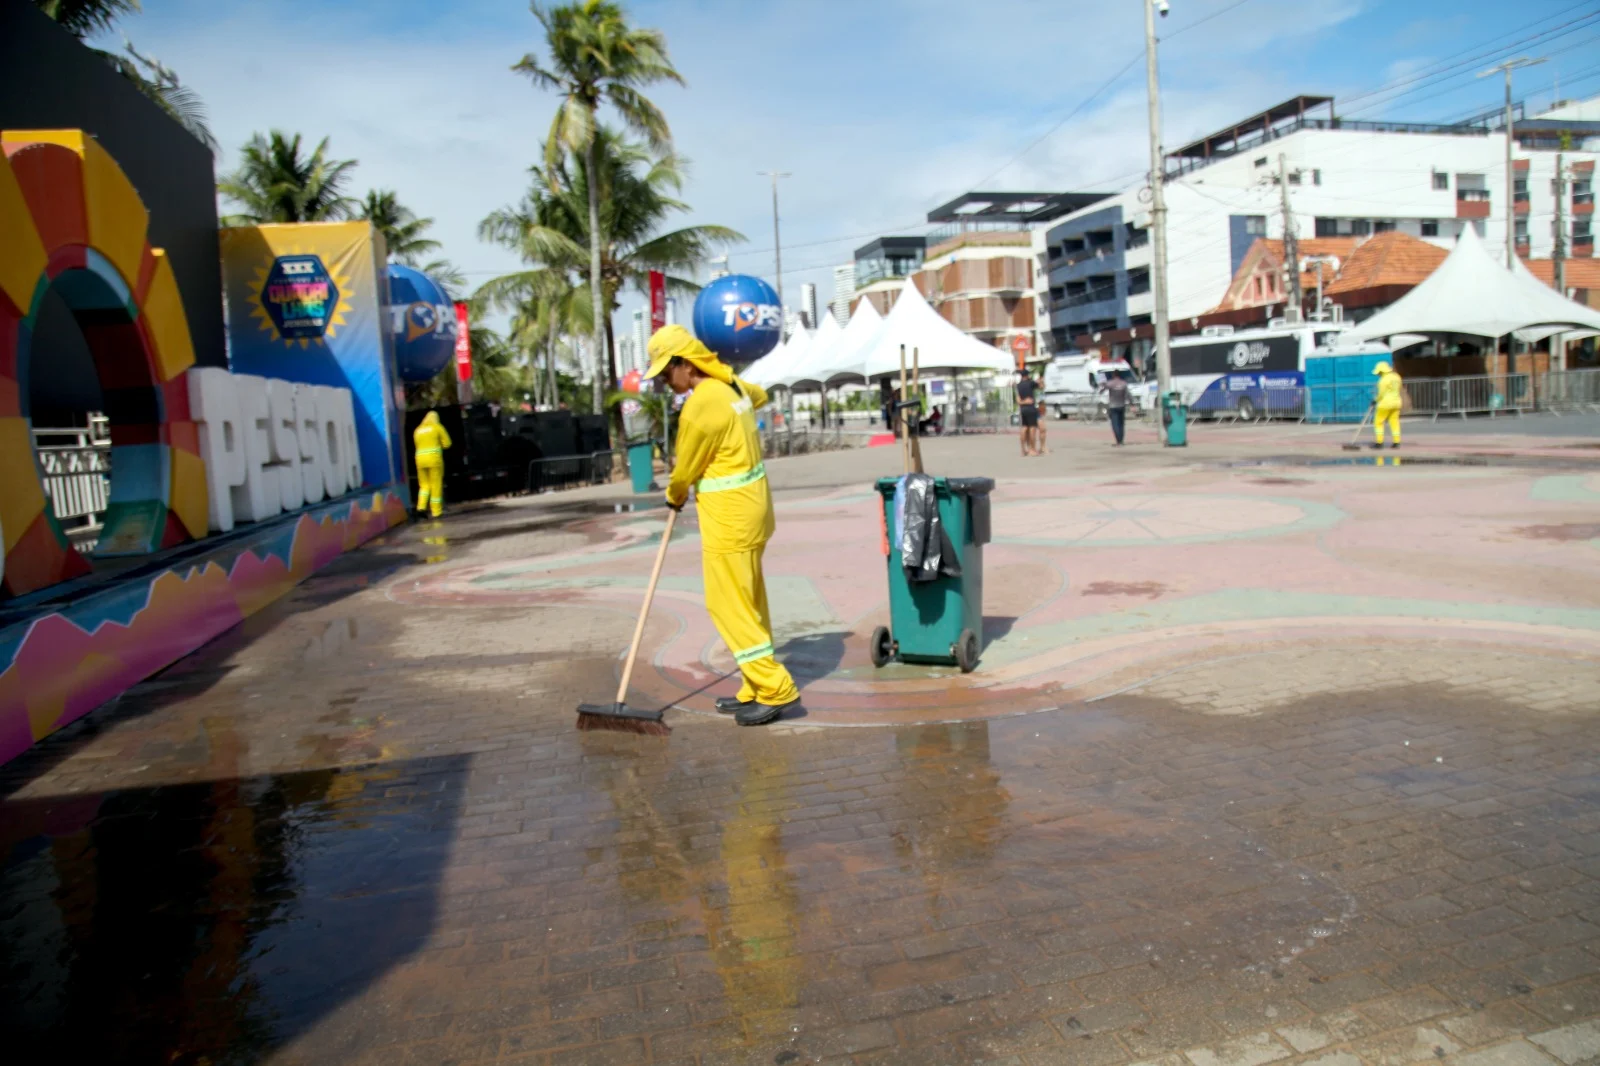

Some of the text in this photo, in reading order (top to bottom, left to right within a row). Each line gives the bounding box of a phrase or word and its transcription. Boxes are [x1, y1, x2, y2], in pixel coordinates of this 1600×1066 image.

[281, 261, 315, 275] XXX
[721, 302, 782, 331] TOPS
[188, 366, 363, 532] PESSOA
